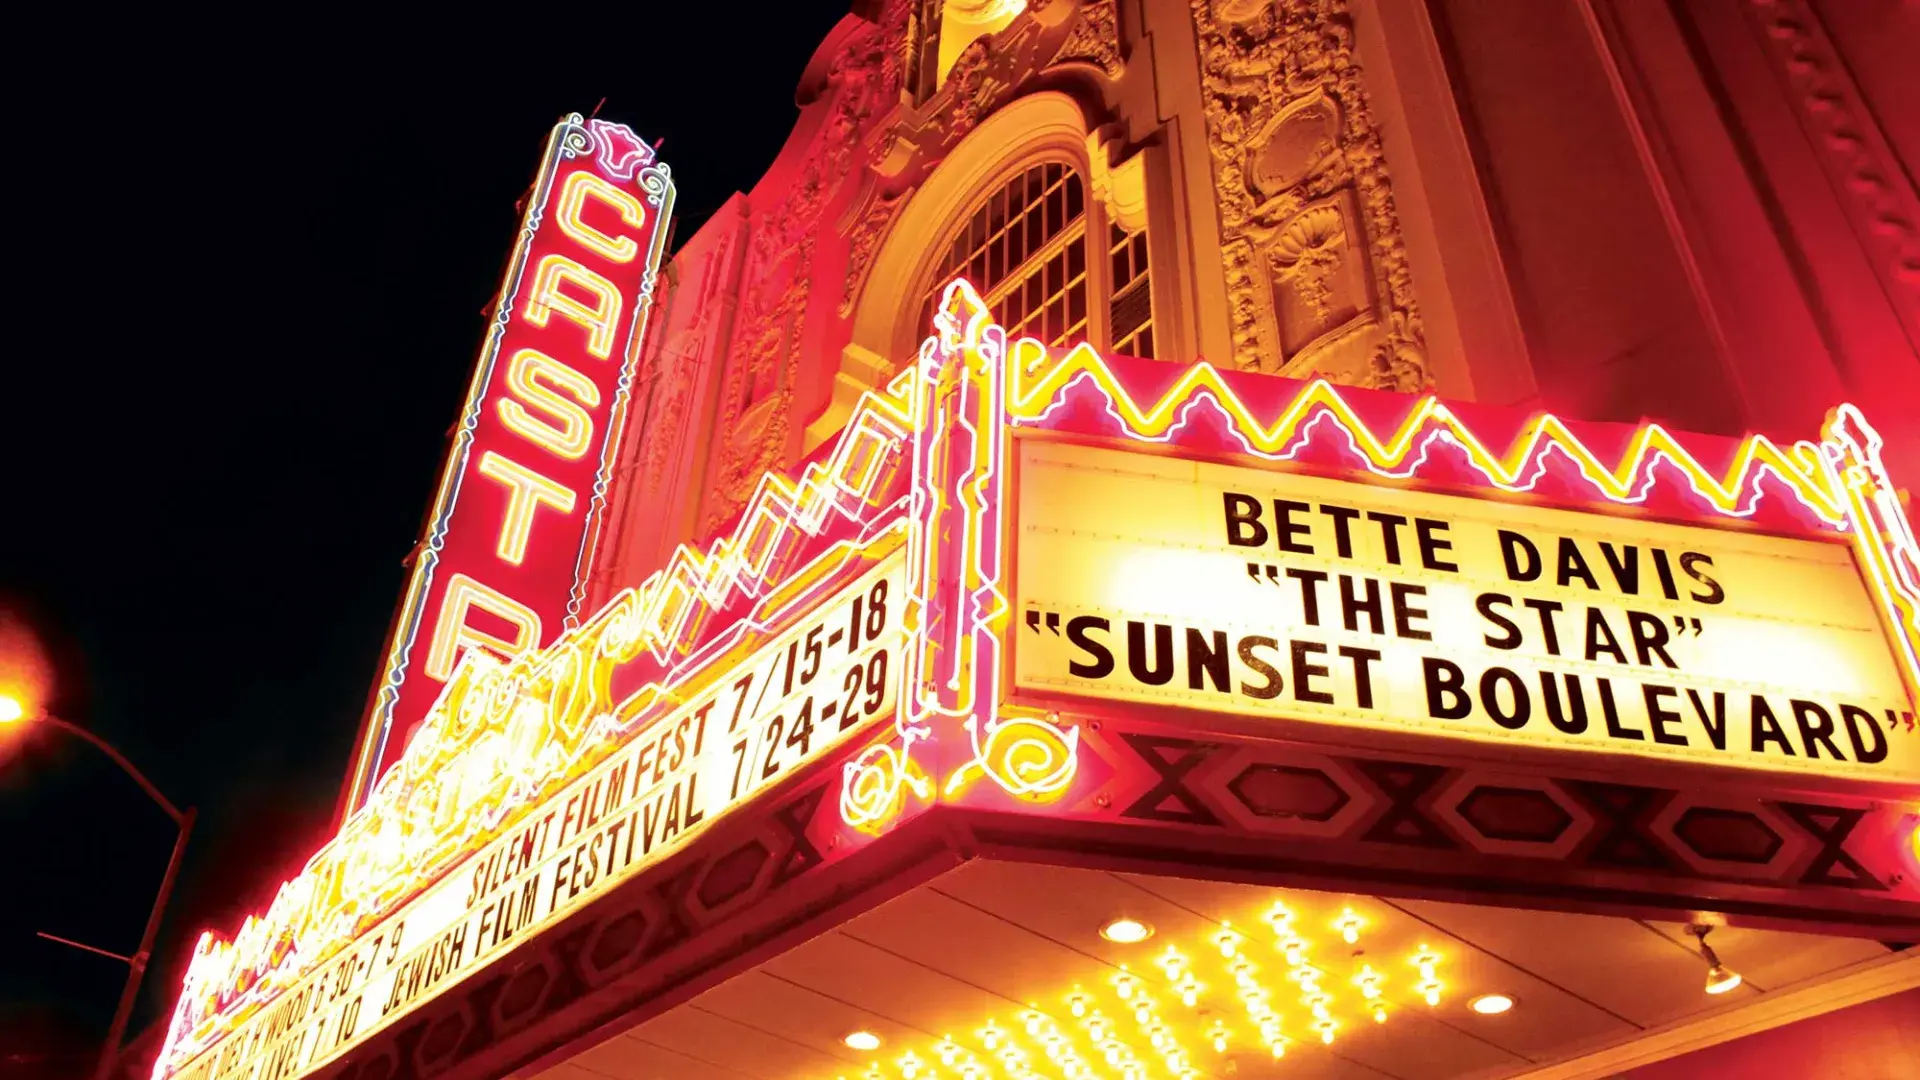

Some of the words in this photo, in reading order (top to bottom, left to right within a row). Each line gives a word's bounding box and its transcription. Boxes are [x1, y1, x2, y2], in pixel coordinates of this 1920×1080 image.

[415, 170, 645, 700] CASTR
[1223, 492, 1458, 573] BETTE
[1497, 529, 1725, 605] DAVIS
[1026, 610, 1381, 709] "SUNSET
[1422, 657, 1915, 764] BOULEVARD"
[1247, 562, 1432, 641] "THE
[1475, 593, 1703, 669] STAR"
[383, 920, 468, 1016] JEWISH
[474, 876, 539, 957] FILM
[549, 772, 703, 912] FESTIVAL
[730, 648, 888, 800] 7/24-29
[466, 815, 555, 909] SILENT
[559, 764, 626, 849] FILM
[631, 699, 716, 789] FEST
[728, 579, 888, 733] 7/15-18
